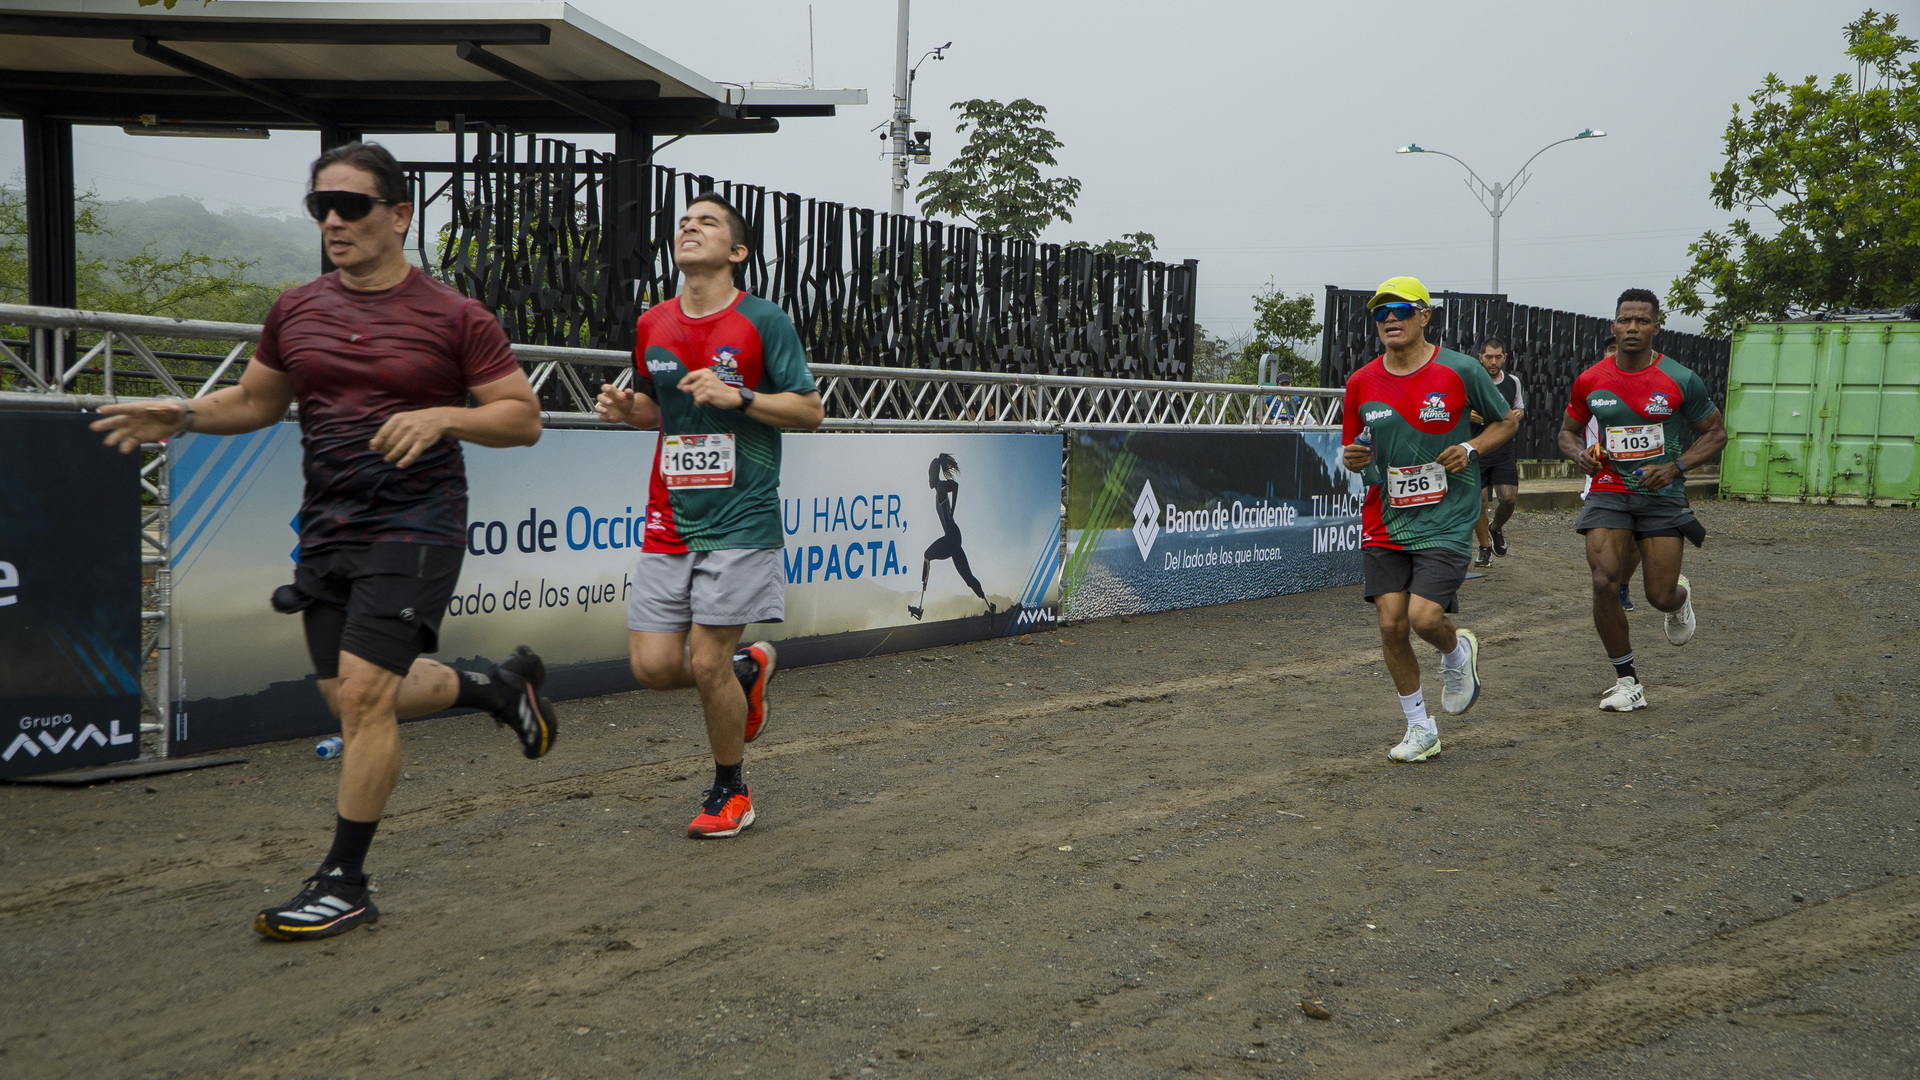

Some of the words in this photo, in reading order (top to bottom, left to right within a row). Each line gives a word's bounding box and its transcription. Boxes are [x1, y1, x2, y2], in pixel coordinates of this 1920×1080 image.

[1621, 436, 1649, 450] 103
[672, 451, 721, 471] 1632
[1396, 476, 1430, 495] 756
[784, 498, 801, 535] U
[813, 494, 908, 533] HACER,
[1165, 503, 1209, 534] Banco
[1212, 501, 1229, 530] de
[1231, 500, 1295, 529] Occidente
[1311, 495, 1328, 520] TU
[1332, 493, 1365, 518] HACE
[517, 507, 558, 553] de
[566, 505, 648, 551] Occid
[1312, 524, 1363, 554] IMPACT
[783, 540, 908, 585] MPACTA.
[1164, 551, 1181, 571] Del
[1182, 549, 1204, 569] lado
[1206, 547, 1218, 566] de
[1219, 545, 1233, 564] los
[1235, 549, 1251, 568] que
[1253, 543, 1282, 562] hacen.
[449, 583, 497, 616] ado
[503, 580, 532, 611] de
[539, 578, 570, 609] los
[577, 582, 616, 613] que
[1017, 607, 1056, 625] AVAL
[19, 713, 73, 730] Grupo
[1, 720, 134, 762] AVAL
